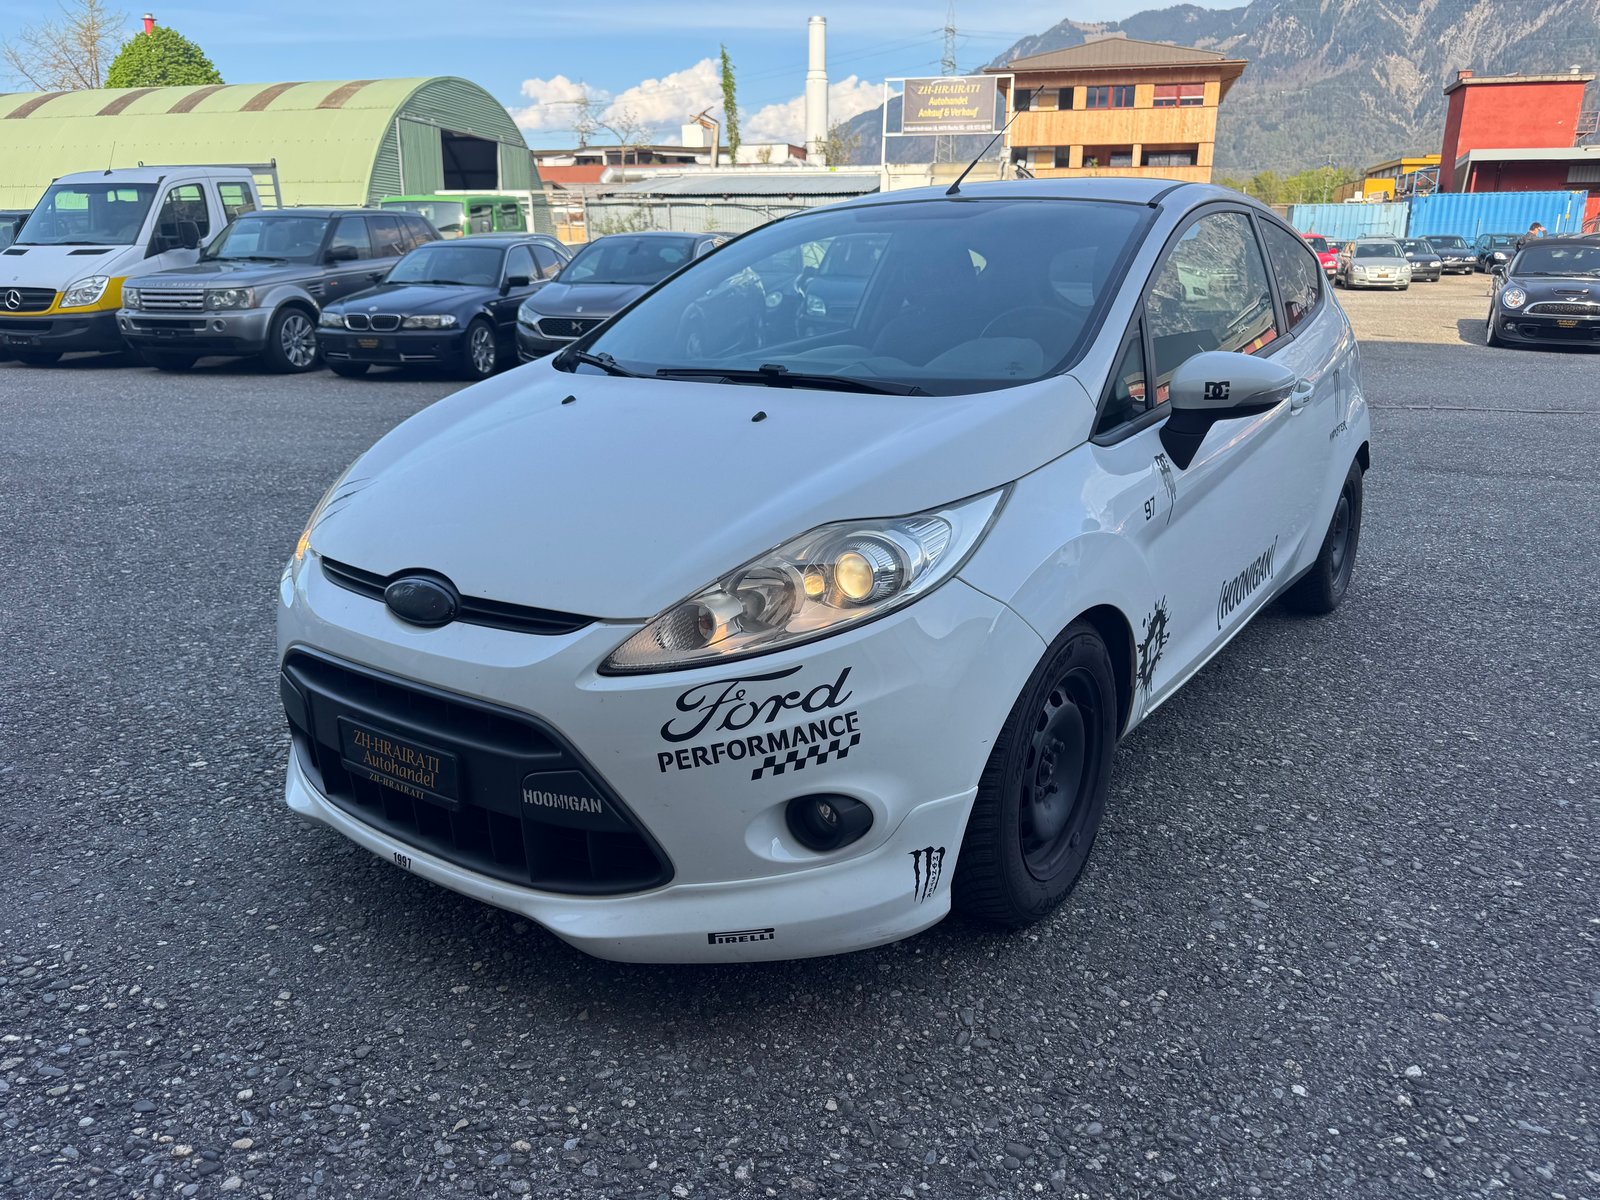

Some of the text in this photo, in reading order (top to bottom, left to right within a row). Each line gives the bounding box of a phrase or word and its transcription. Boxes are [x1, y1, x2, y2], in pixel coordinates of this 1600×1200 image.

[918, 83, 981, 95] ZH-HRAIRATI
[928, 96, 969, 106] Autohandel
[1203, 381, 1231, 401] DC
[1144, 495, 1156, 521] 97
[660, 665, 853, 743] Ford
[353, 729, 440, 774] ZH-HRAIRATI
[657, 710, 860, 773] PERFORMANCE
[363, 750, 435, 789] Autohandel
[369, 772, 425, 800] ZH-HRAIRATI
[522, 788, 602, 814] HOONIGAN
[393, 851, 412, 870] 1997
[707, 927, 775, 945] PIRELLI
